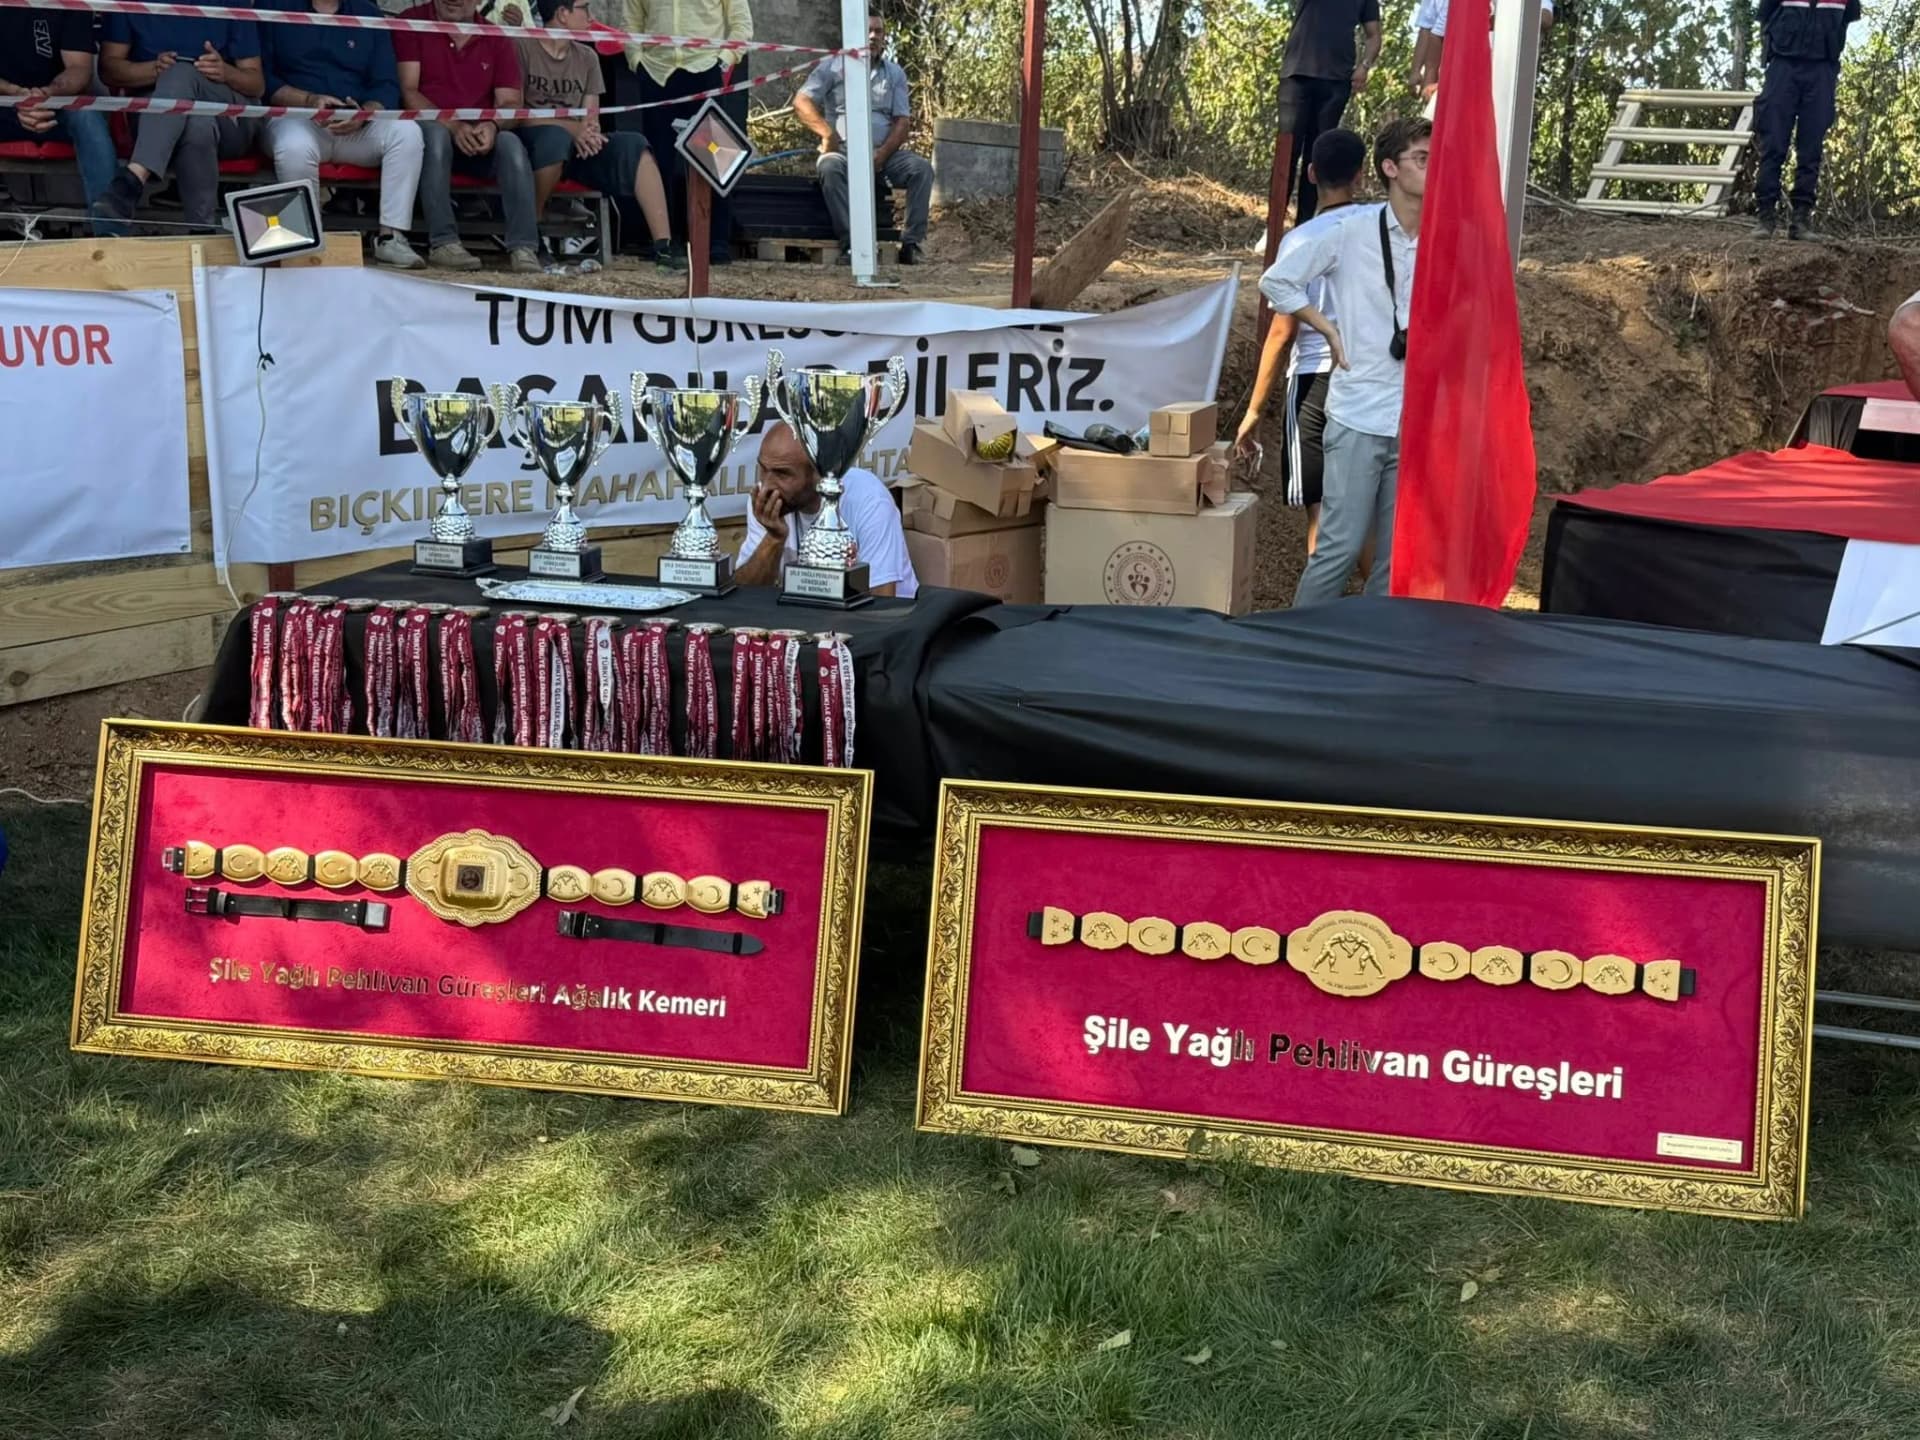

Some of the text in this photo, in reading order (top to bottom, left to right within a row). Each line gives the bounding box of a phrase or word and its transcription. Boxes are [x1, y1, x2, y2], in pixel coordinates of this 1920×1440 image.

[528, 74, 583, 94] PRADA
[414, 628, 423, 659] TÜRKİYE
[516, 632, 525, 663] TÜRKİYE
[560, 632, 570, 663] TÜRKİYE
[652, 635, 660, 666] TÜRKİYE
[688, 639, 697, 671] TÜRKİYE
[518, 663, 527, 708] GELENEKSEL
[209, 957, 726, 1017] Şile Yağlı Pehlivan Güreşleri Ağalık Kemeri
[1083, 1014, 1624, 1100] Şile Yağlı Pehlivan Güreşleri
